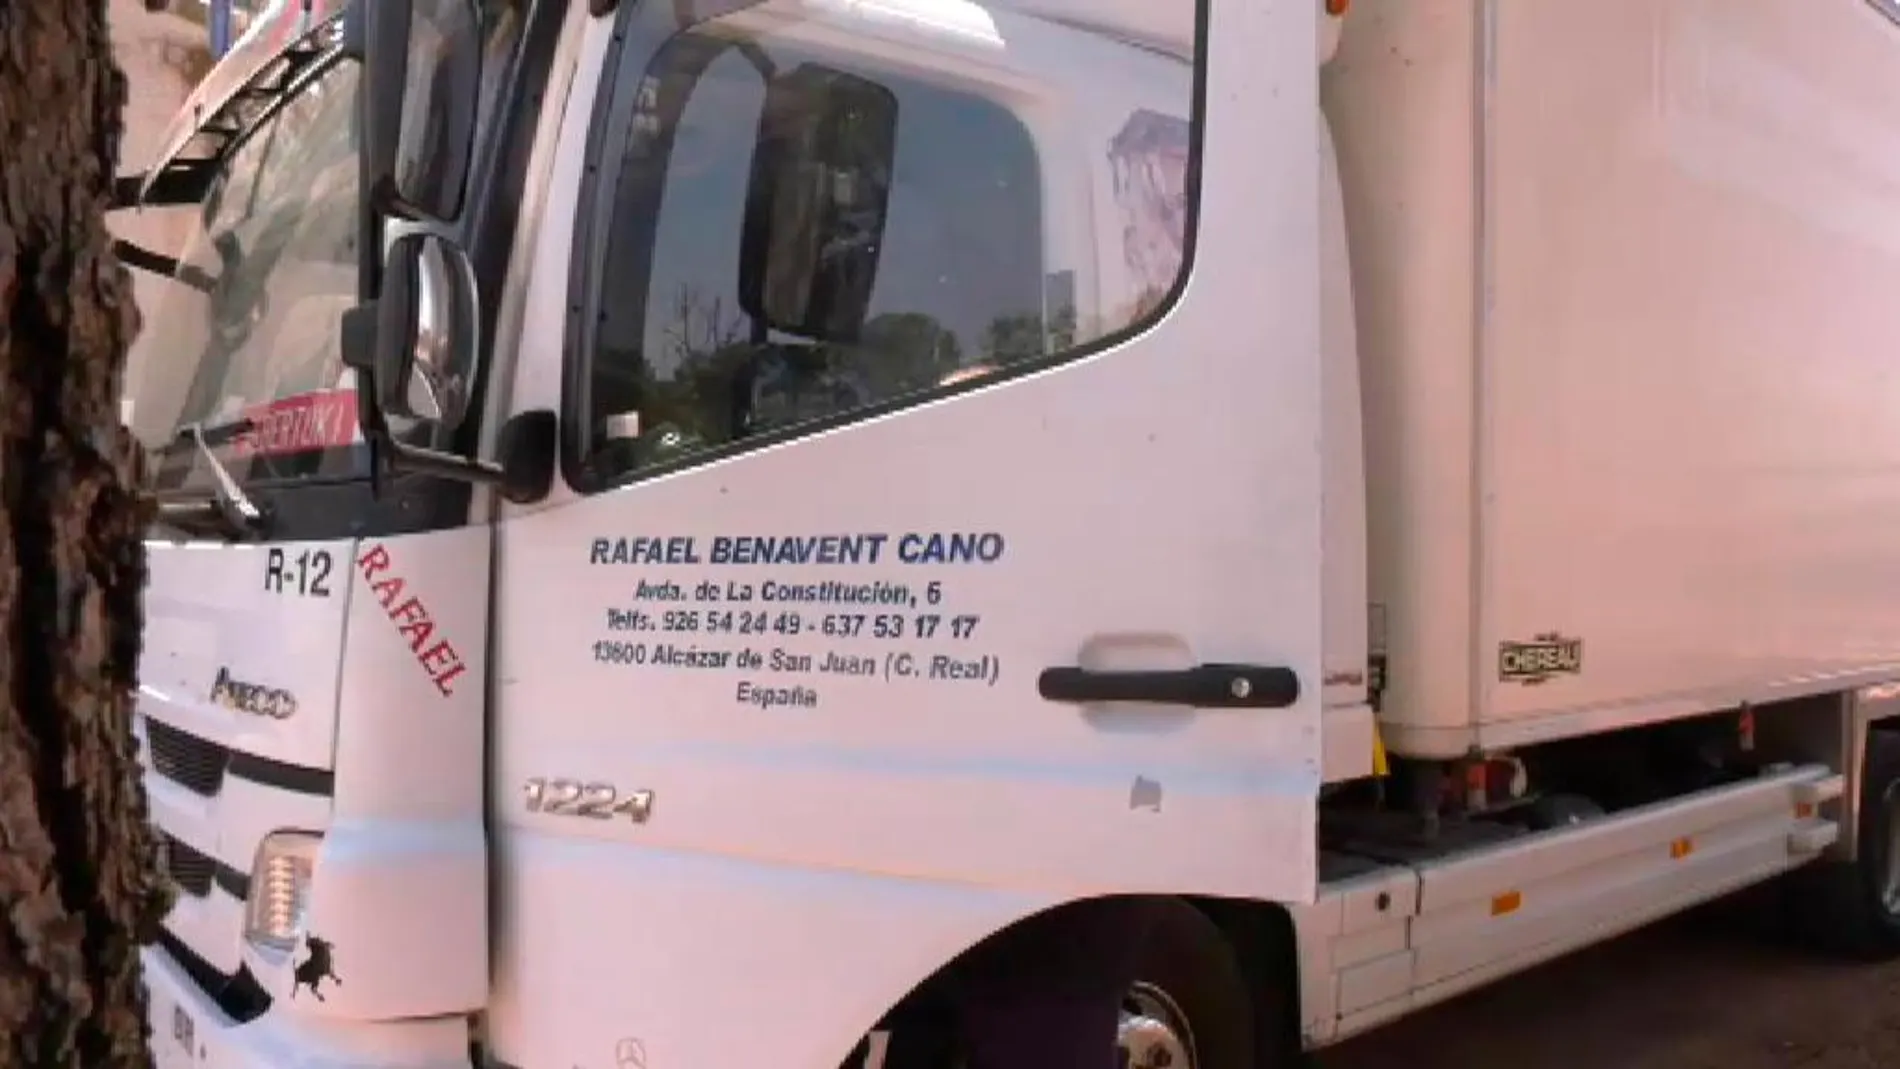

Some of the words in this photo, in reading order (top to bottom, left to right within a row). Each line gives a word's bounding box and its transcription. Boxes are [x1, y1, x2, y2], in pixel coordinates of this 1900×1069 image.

[590, 536, 701, 564] RAFAEL
[709, 534, 888, 564] BENAVENT
[898, 532, 1005, 564] CANO
[264, 548, 332, 597] R-12
[634, 579, 687, 601] Avda.
[695, 580, 720, 601] de
[726, 581, 752, 601] La
[762, 580, 917, 608] Constitución,
[926, 581, 942, 605] 6
[357, 543, 466, 697] RAFAEL
[607, 607, 656, 632] Telfs.
[662, 610, 699, 632] 926
[706, 611, 733, 633] 54
[739, 611, 768, 635] 24
[773, 612, 801, 636] 49
[822, 614, 865, 638] 637
[873, 614, 904, 639] 53
[914, 614, 941, 639] 17
[951, 615, 981, 640] 17
[592, 640, 648, 665] 13600
[650, 643, 733, 669] Alcázar
[736, 648, 762, 670] de
[770, 648, 811, 673] San
[820, 652, 875, 676] Juan
[884, 652, 920, 684] (C.
[929, 655, 1000, 687] Real)
[1502, 646, 1577, 673] CHEREAU
[736, 681, 818, 709] España
[523, 777, 656, 825] 1224
